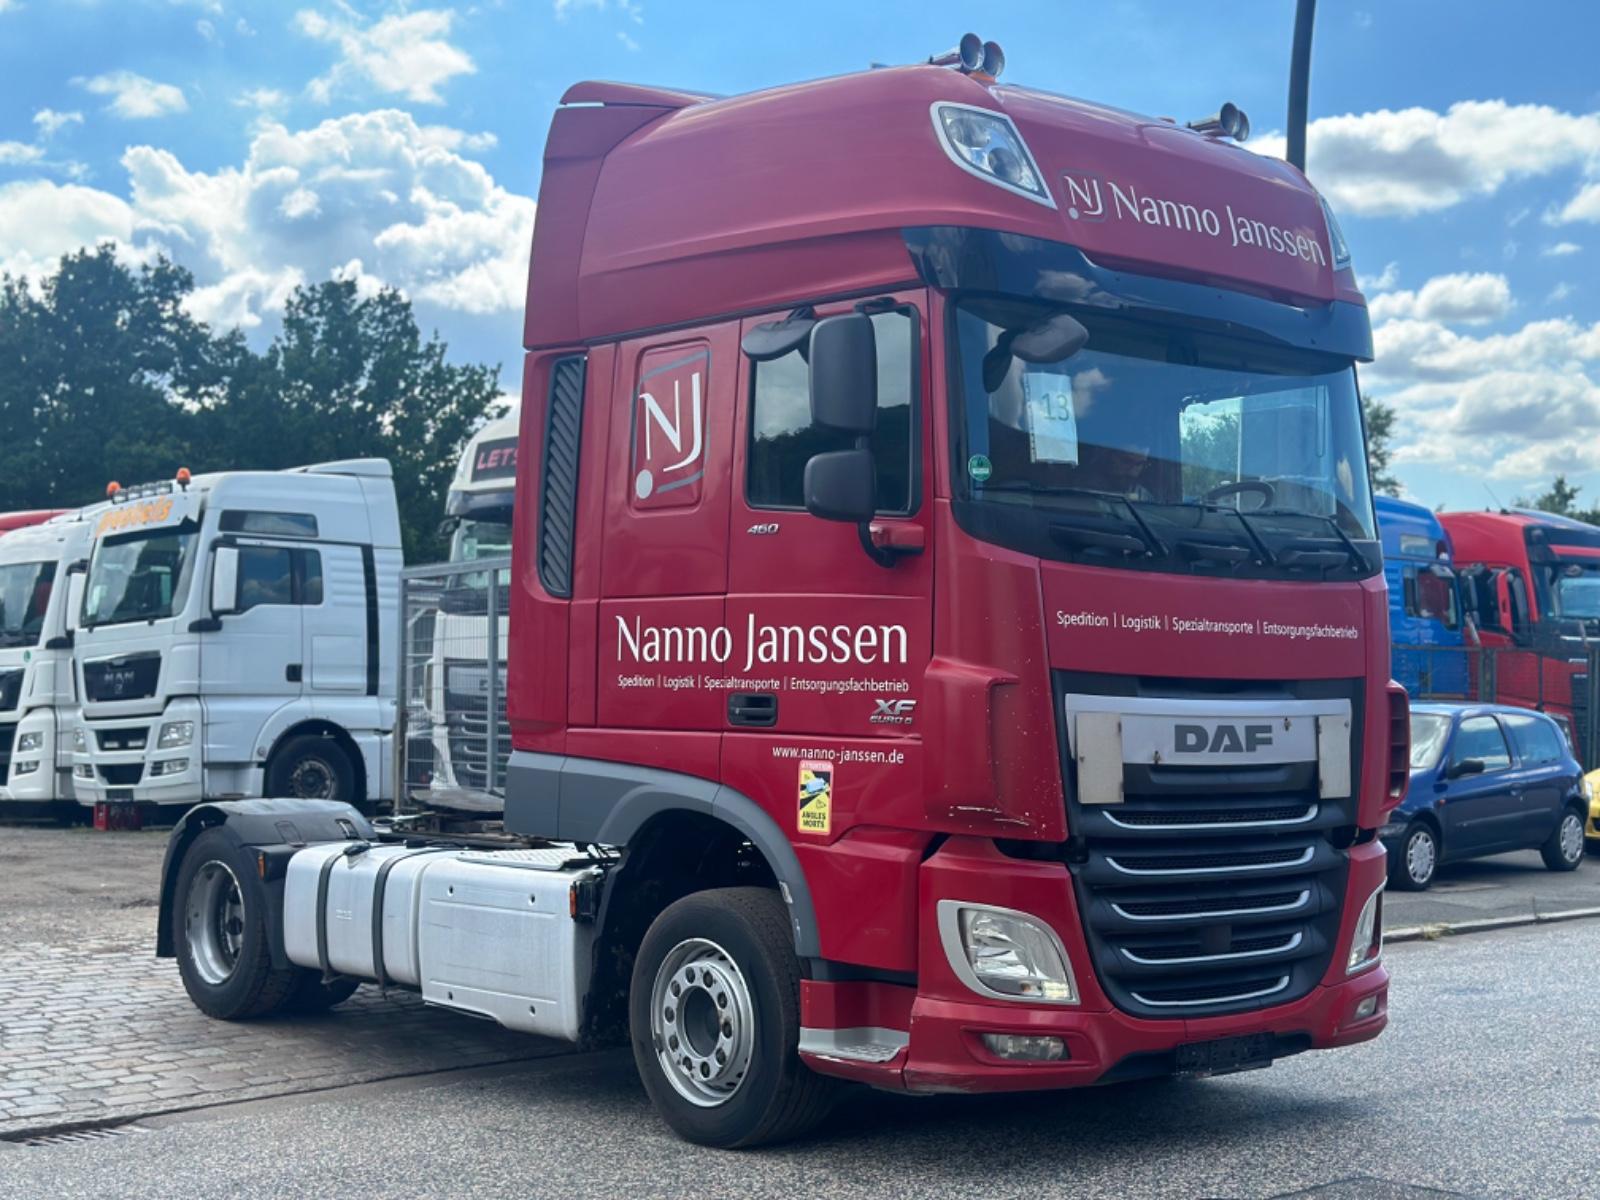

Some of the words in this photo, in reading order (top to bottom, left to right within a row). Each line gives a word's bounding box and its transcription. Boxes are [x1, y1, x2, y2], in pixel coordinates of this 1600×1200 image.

[1063, 175, 1104, 216] NJ
[1107, 182, 1220, 237] Nanno
[1226, 205, 1327, 267] Janssen
[639, 372, 703, 472] NJ
[1041, 393, 1070, 422] 13
[747, 523, 779, 535] 460
[1056, 610, 1109, 629] Spedition
[1121, 614, 1162, 632] Logistik
[1172, 616, 1254, 636] Spezialtransporte
[1263, 621, 1359, 640] Entsorgungsfachbetrieb
[615, 615, 733, 663] Nanno
[743, 613, 907, 672] Janssen
[617, 674, 655, 688] Spedition
[663, 675, 695, 691] Logistik
[704, 676, 780, 692] Spezialtransporte
[791, 677, 909, 694] Entsorgungsfachbetrieb
[872, 698, 917, 715] XF
[1174, 724, 1273, 753] DAF
[772, 746, 904, 764] www.nanno-janssen.de
